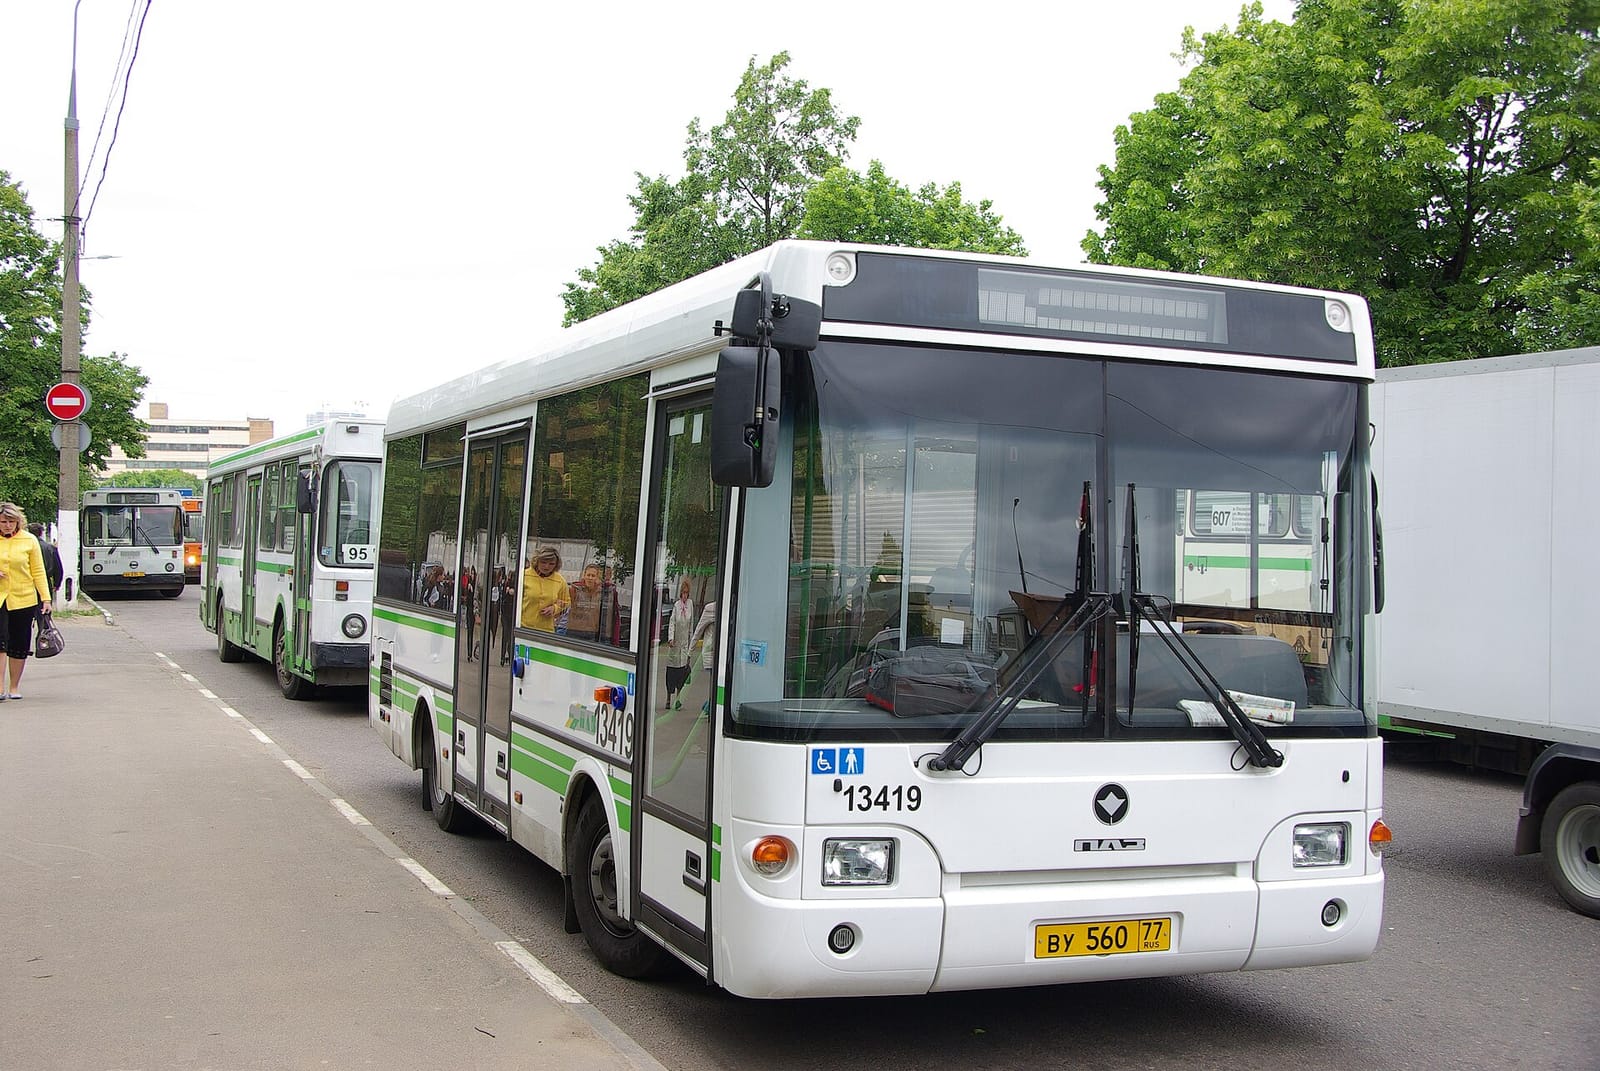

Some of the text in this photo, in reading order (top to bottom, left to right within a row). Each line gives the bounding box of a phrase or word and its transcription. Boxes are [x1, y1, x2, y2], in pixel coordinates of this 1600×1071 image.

[1212, 511, 1231, 526] 607
[349, 547, 368, 560] 95
[594, 701, 634, 759] 13419
[843, 785, 922, 811] 13419
[1086, 925, 1128, 951] 560
[1142, 921, 1163, 941] 77
[1143, 941, 1160, 949] RUS
